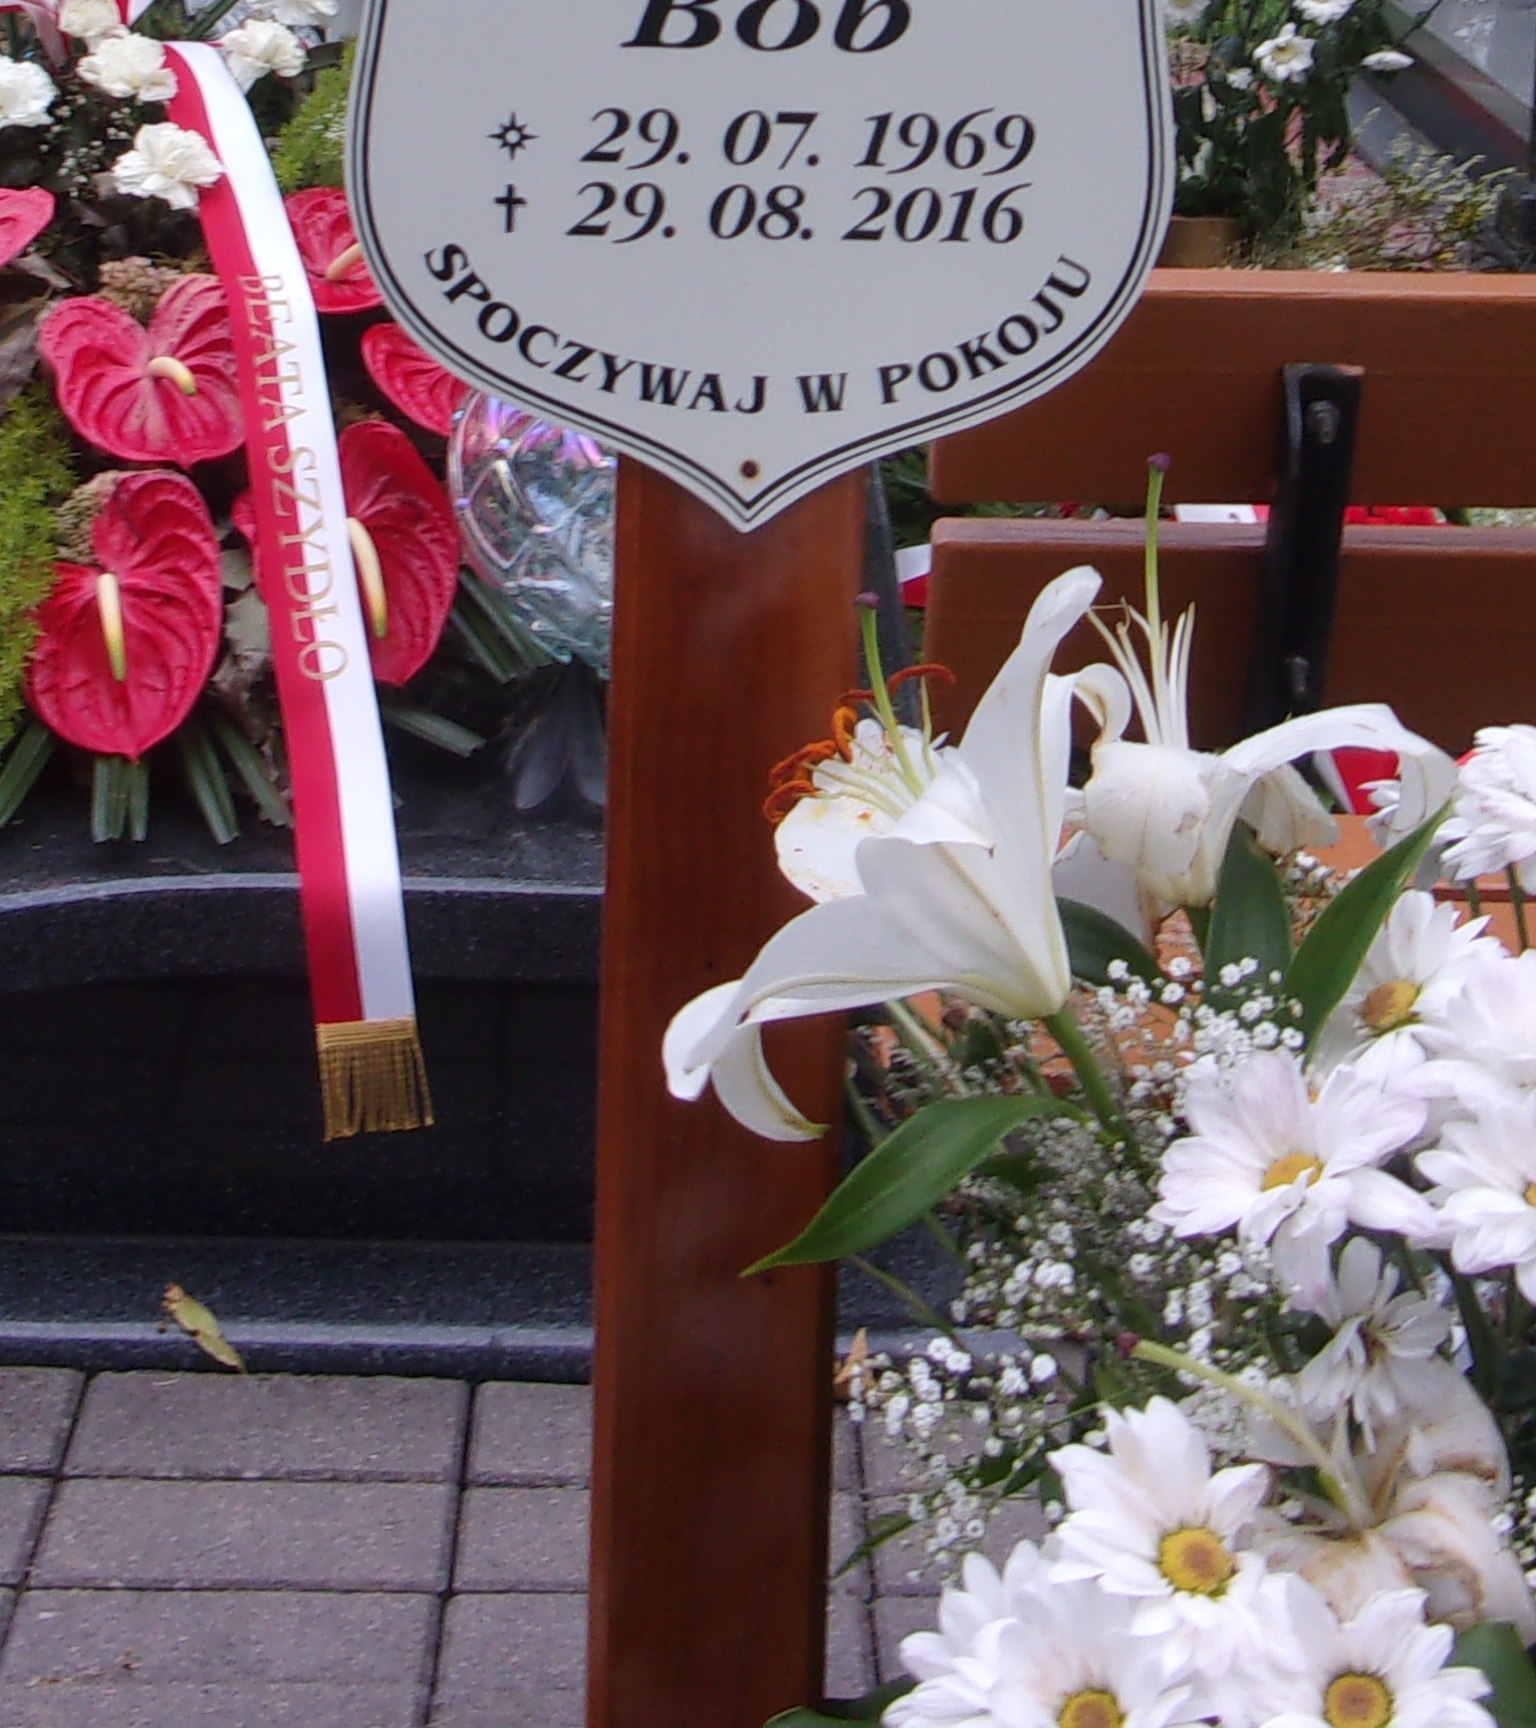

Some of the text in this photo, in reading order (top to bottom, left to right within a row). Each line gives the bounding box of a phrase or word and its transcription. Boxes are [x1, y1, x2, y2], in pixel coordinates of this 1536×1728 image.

[579, 107, 1036, 177] 29. 07. 1969
[564, 181, 1034, 244] 29. 08. 2016
[423, 243, 1093, 414] SPOCZYWAJ W POKOJU
[239, 273, 349, 683] BEATA SZYDŁO
